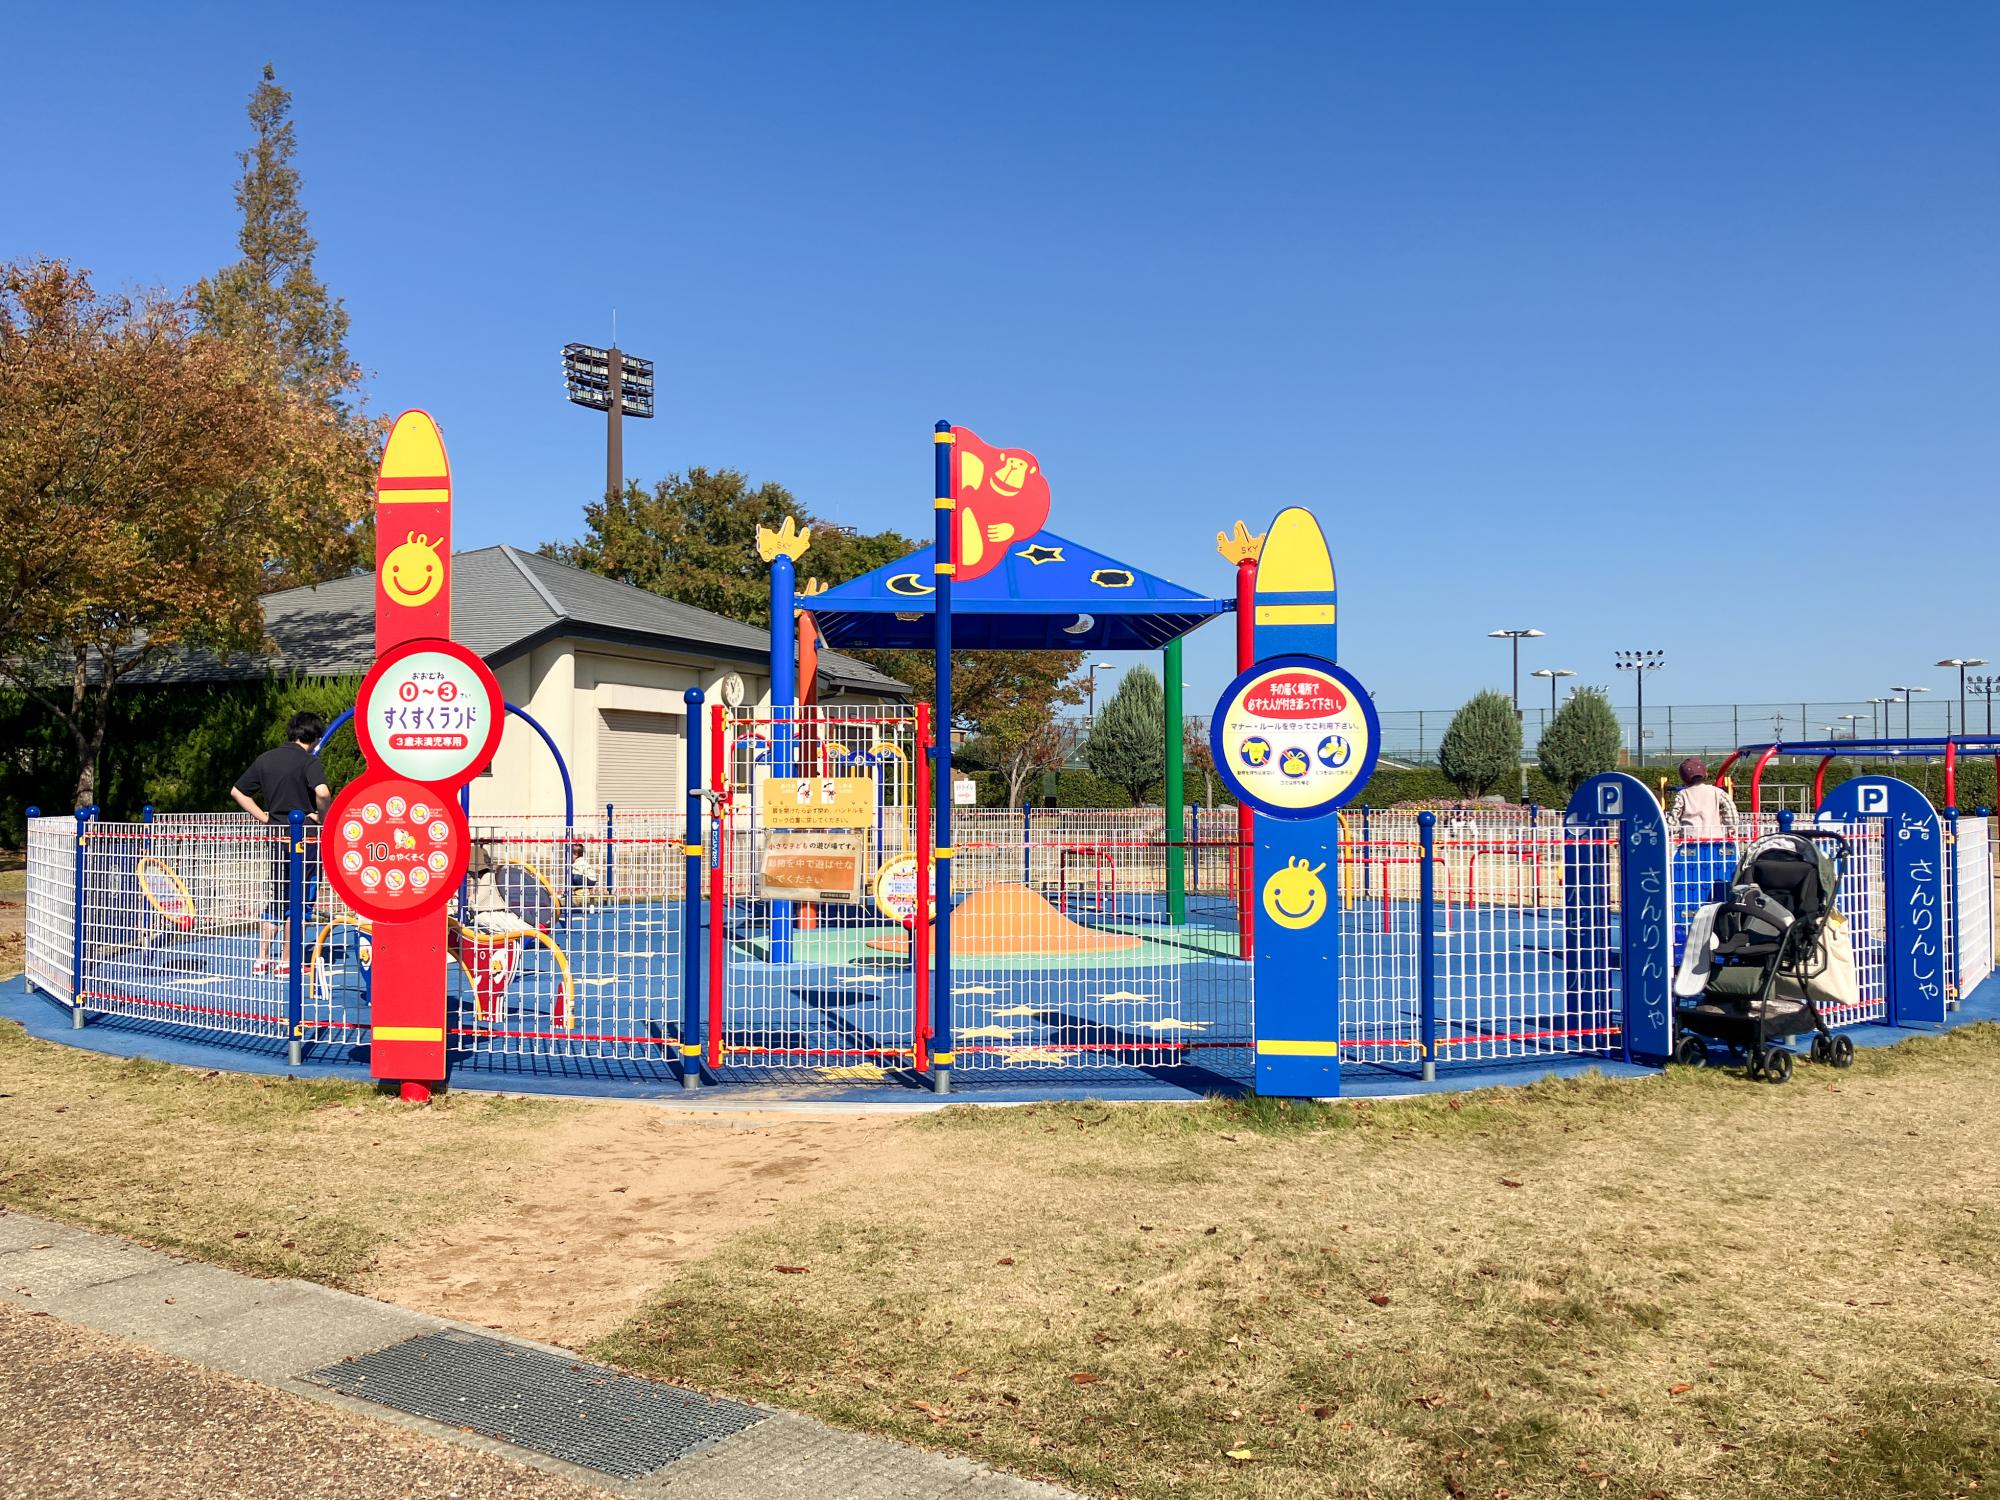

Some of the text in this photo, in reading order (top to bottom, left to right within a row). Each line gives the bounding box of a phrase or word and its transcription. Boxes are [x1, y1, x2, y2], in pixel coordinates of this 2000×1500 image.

[412, 672, 445, 680] おおむね
[1270, 683, 1320, 696] 手の届く場所で
[1248, 698, 1342, 711] 必ず大人が付き添って下さい。
[384, 707, 477, 729] すくすくランド
[1602, 785, 1620, 812] P
[1863, 788, 1884, 812] P
[365, 842, 425, 862] 10のやくそく
[768, 842, 856, 851] 小さな子どもの遊び場です。
[1909, 859, 1939, 1000] さんりんしゃ
[1640, 867, 1665, 1030] さんりんしゃ
